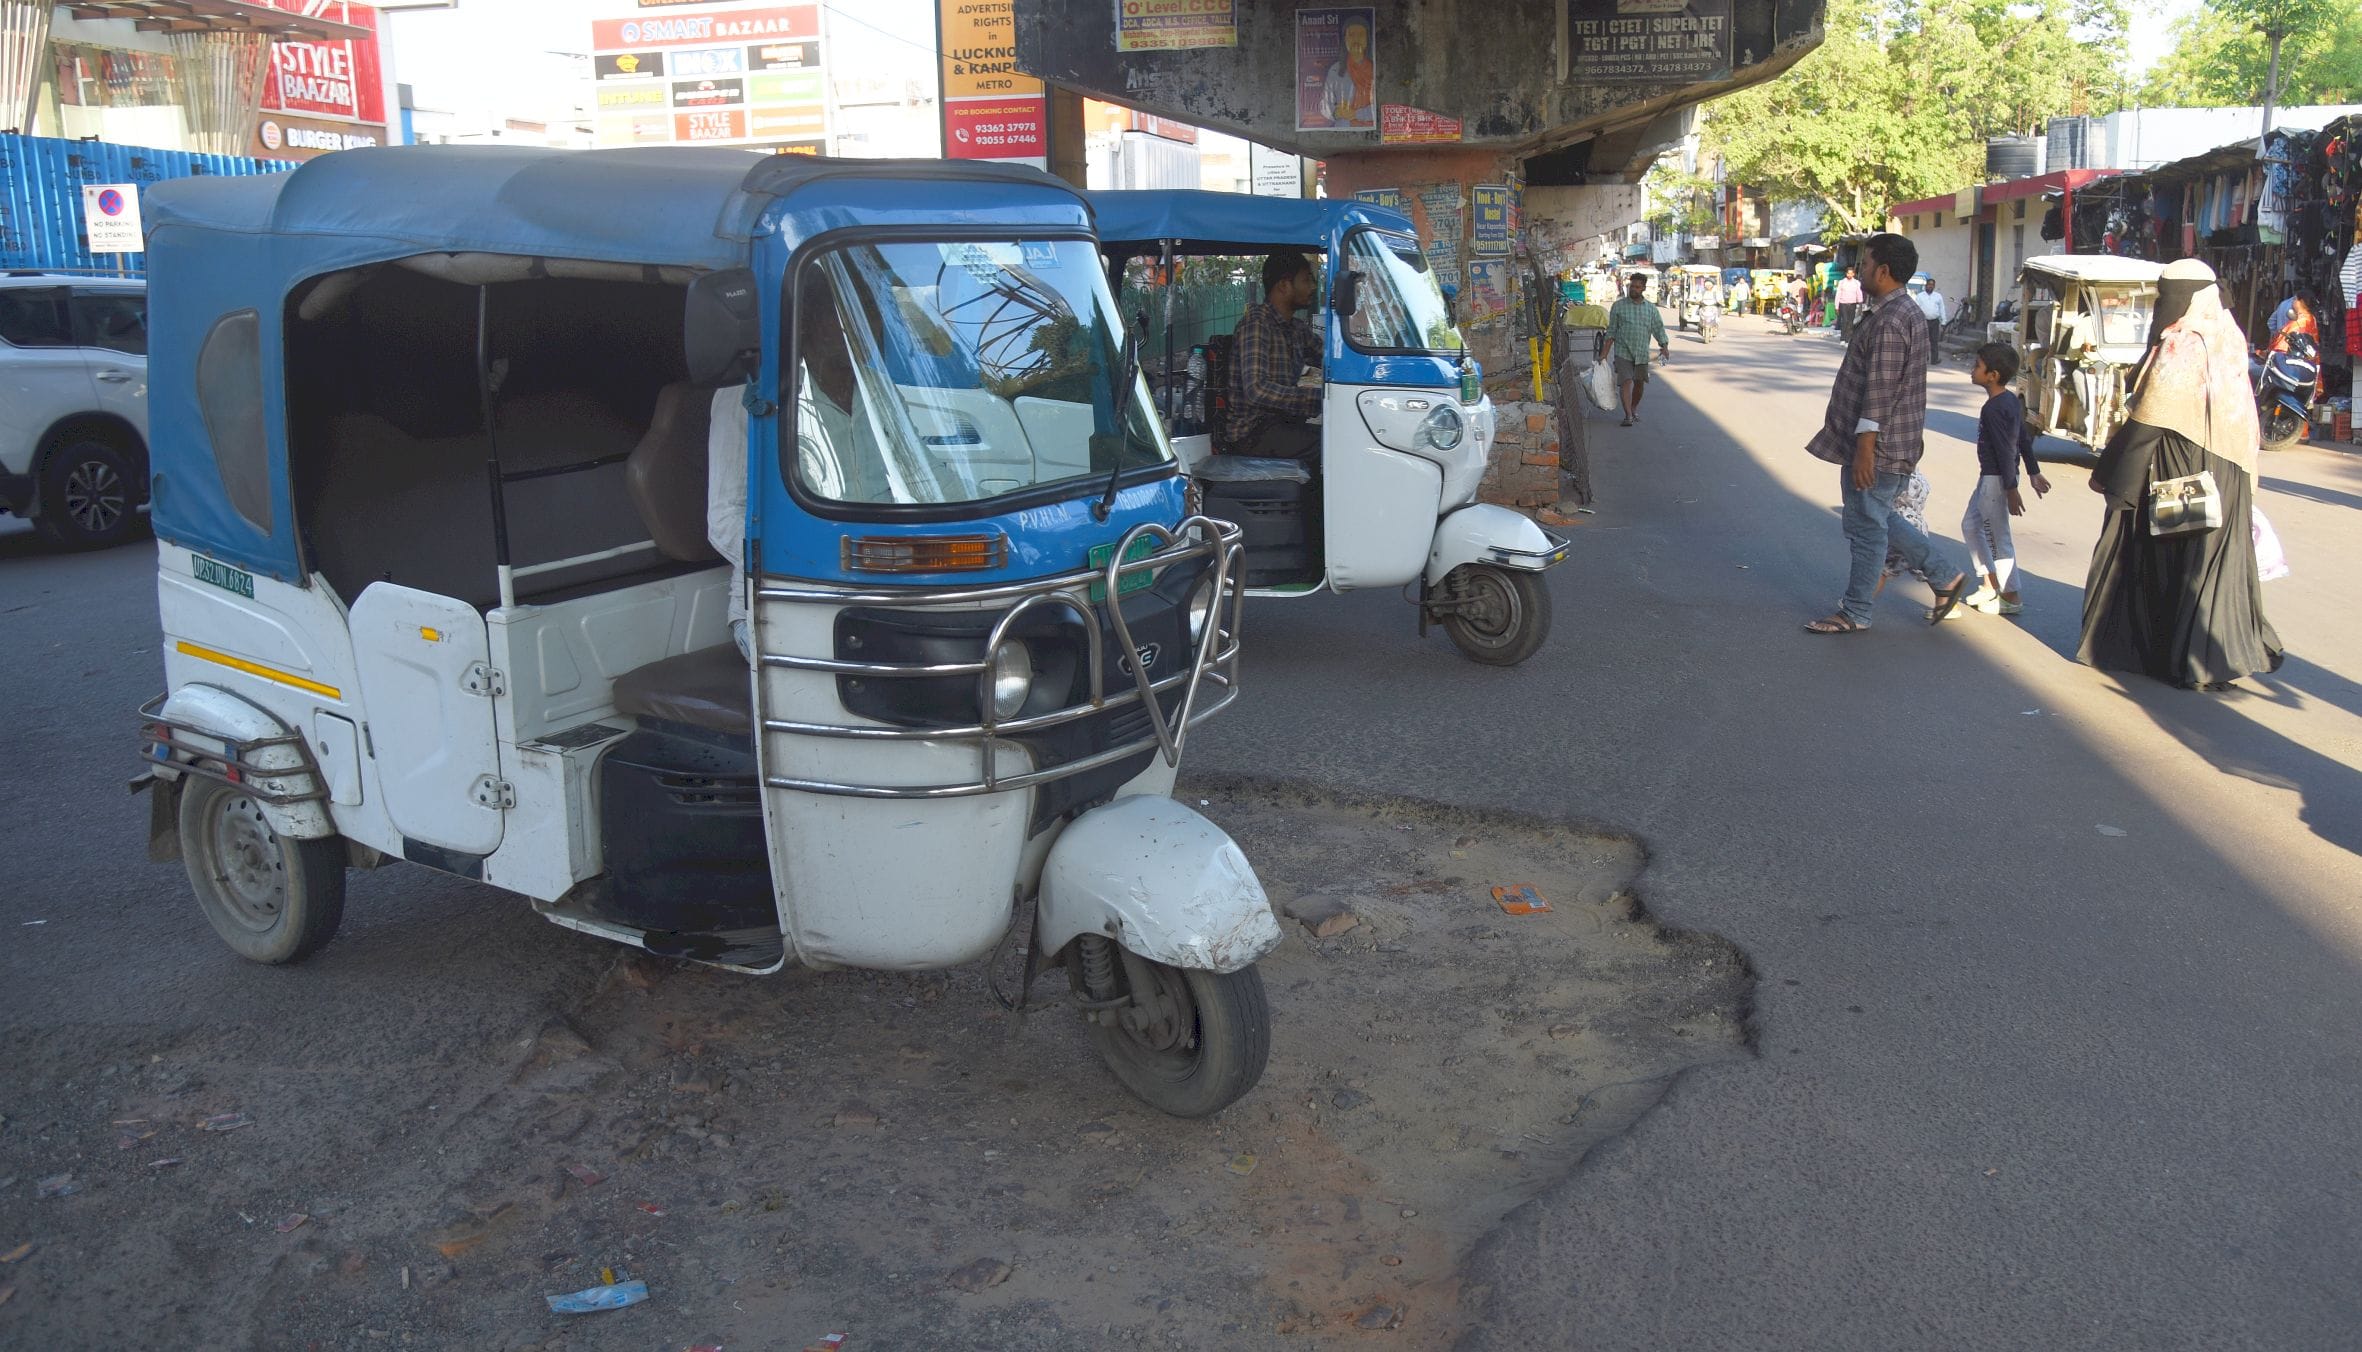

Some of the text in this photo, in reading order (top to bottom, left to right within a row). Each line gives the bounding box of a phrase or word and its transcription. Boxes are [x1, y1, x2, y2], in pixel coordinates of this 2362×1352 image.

[642, 17, 791, 41] SMART BAZAAR
[973, 17, 1012, 27] RIGHTS
[1575, 15, 1724, 35] TET CTET SUPER TET
[988, 31, 997, 40] in
[1583, 33, 1716, 51] TGT PGT NET JRF
[281, 41, 349, 81] STYLE
[953, 64, 964, 75] &
[283, 74, 352, 106] BAAZAR
[976, 79, 1013, 90] METRO
[969, 107, 1003, 116] BOOKING
[1003, 106, 1036, 114] CONTACT
[688, 111, 730, 129] STYLE
[689, 127, 732, 140] BAAZAR
[975, 122, 1036, 133] 93362 37978
[286, 127, 377, 151] BURGER KING
[975, 134, 1037, 145] 93055 67446
[1379, 192, 1399, 207] Boy's
